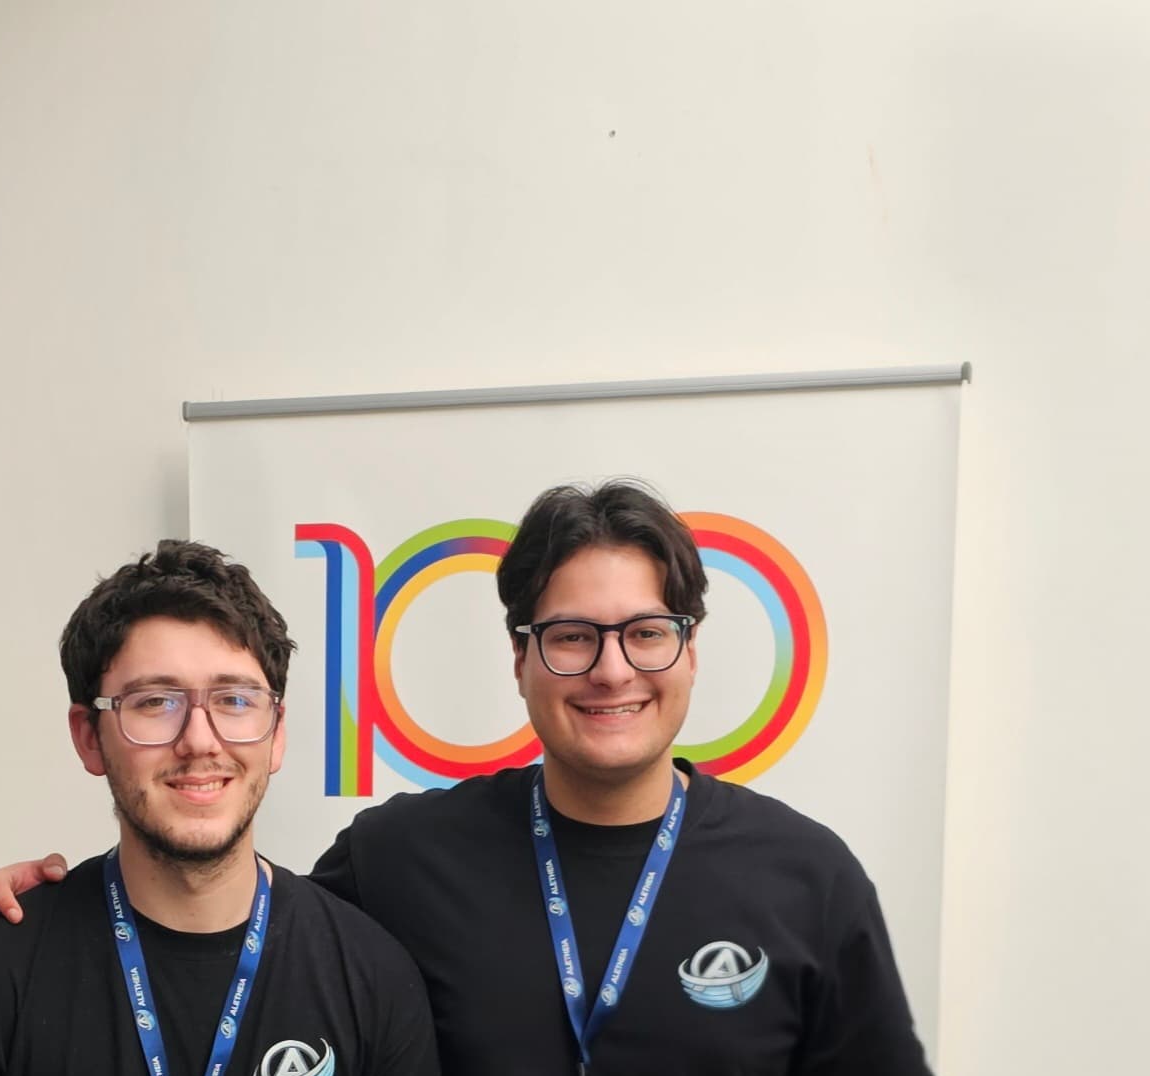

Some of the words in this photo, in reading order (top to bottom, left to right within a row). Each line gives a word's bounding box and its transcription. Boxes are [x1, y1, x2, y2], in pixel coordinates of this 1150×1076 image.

[294, 511, 829, 797] 100
[130, 967, 147, 1007] ALETHEIA
[229, 977, 247, 1017] ALETHEIA
